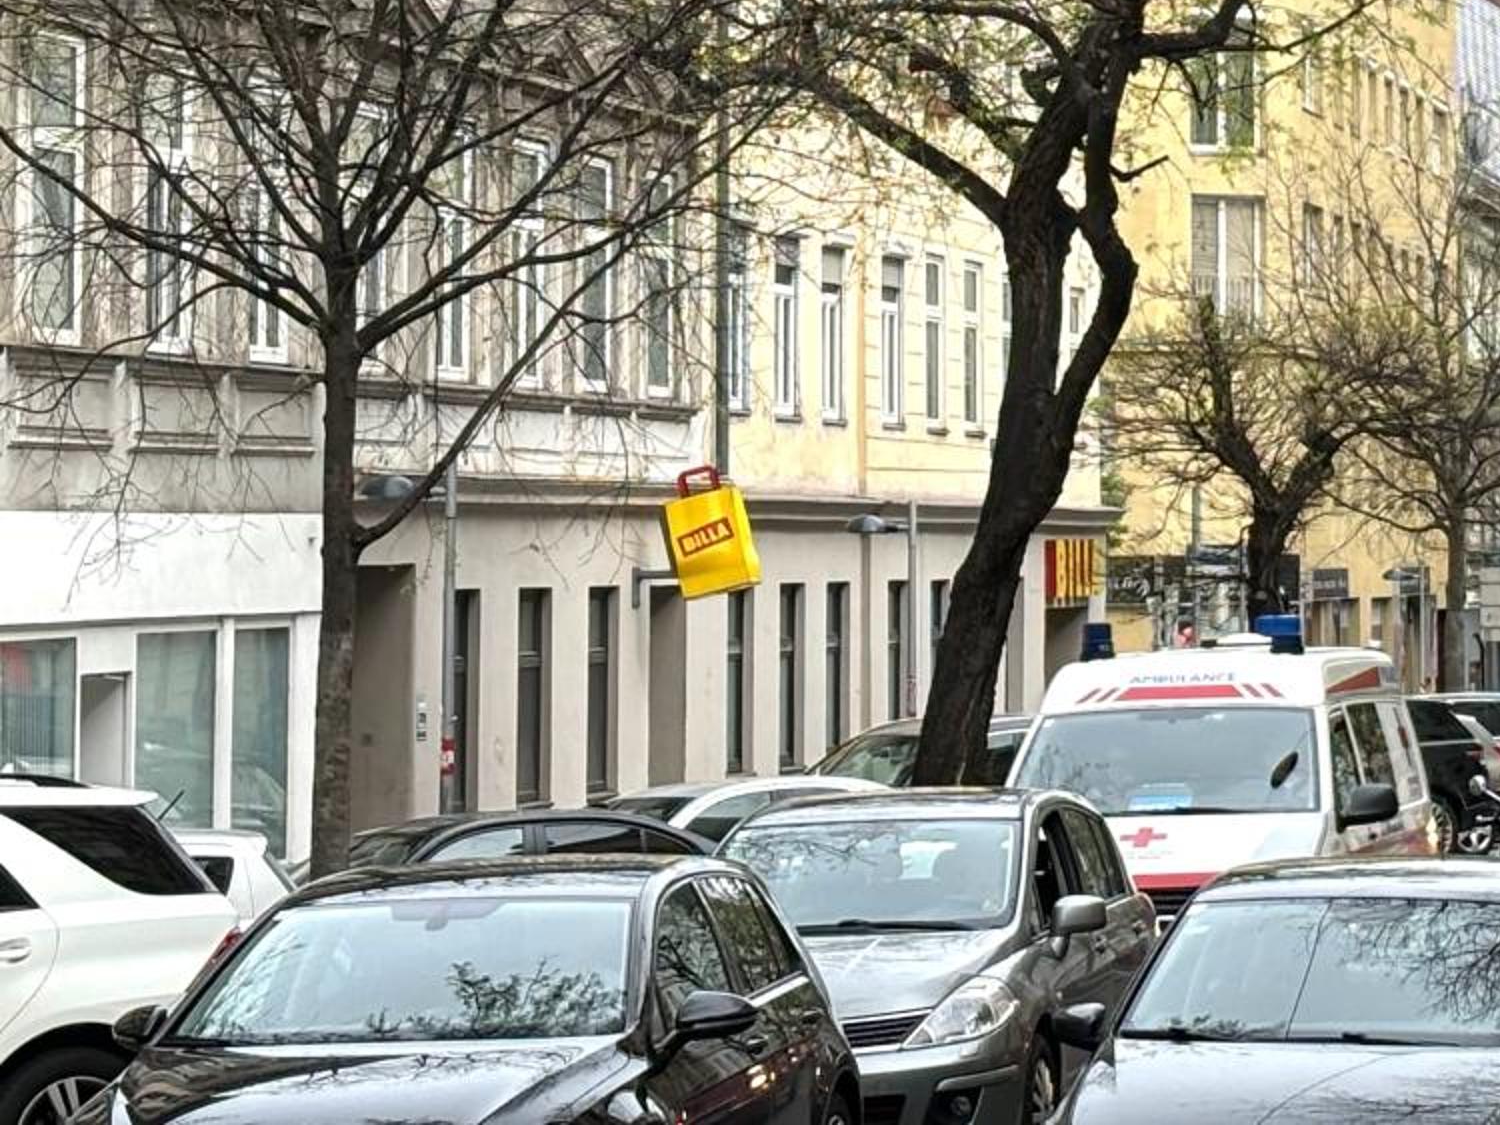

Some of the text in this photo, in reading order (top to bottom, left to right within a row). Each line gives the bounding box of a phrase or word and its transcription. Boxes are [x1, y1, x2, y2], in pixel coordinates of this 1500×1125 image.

[681, 522, 730, 554] BILLA
[1055, 539, 1093, 597] BILL
[1130, 673, 1235, 684] AMBULANCE
